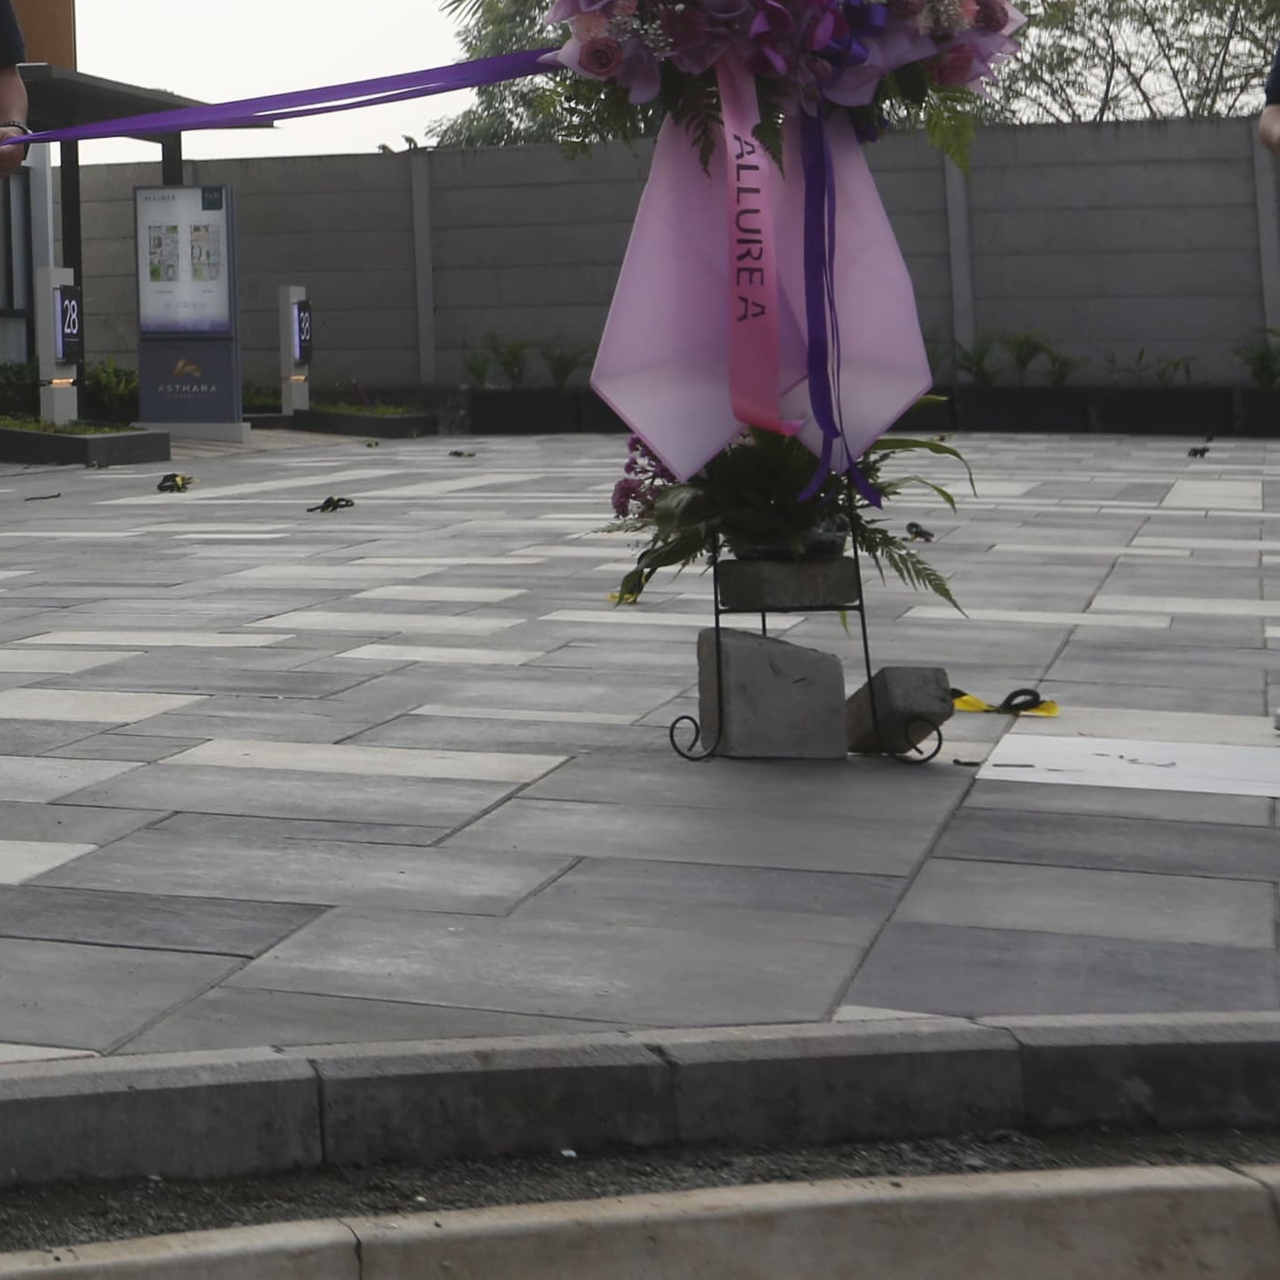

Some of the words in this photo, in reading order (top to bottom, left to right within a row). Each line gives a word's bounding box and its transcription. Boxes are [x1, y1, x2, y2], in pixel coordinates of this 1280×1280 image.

[733, 133, 765, 322] ALLUREA
[63, 299, 79, 334] 28
[299, 312, 311, 341] 38
